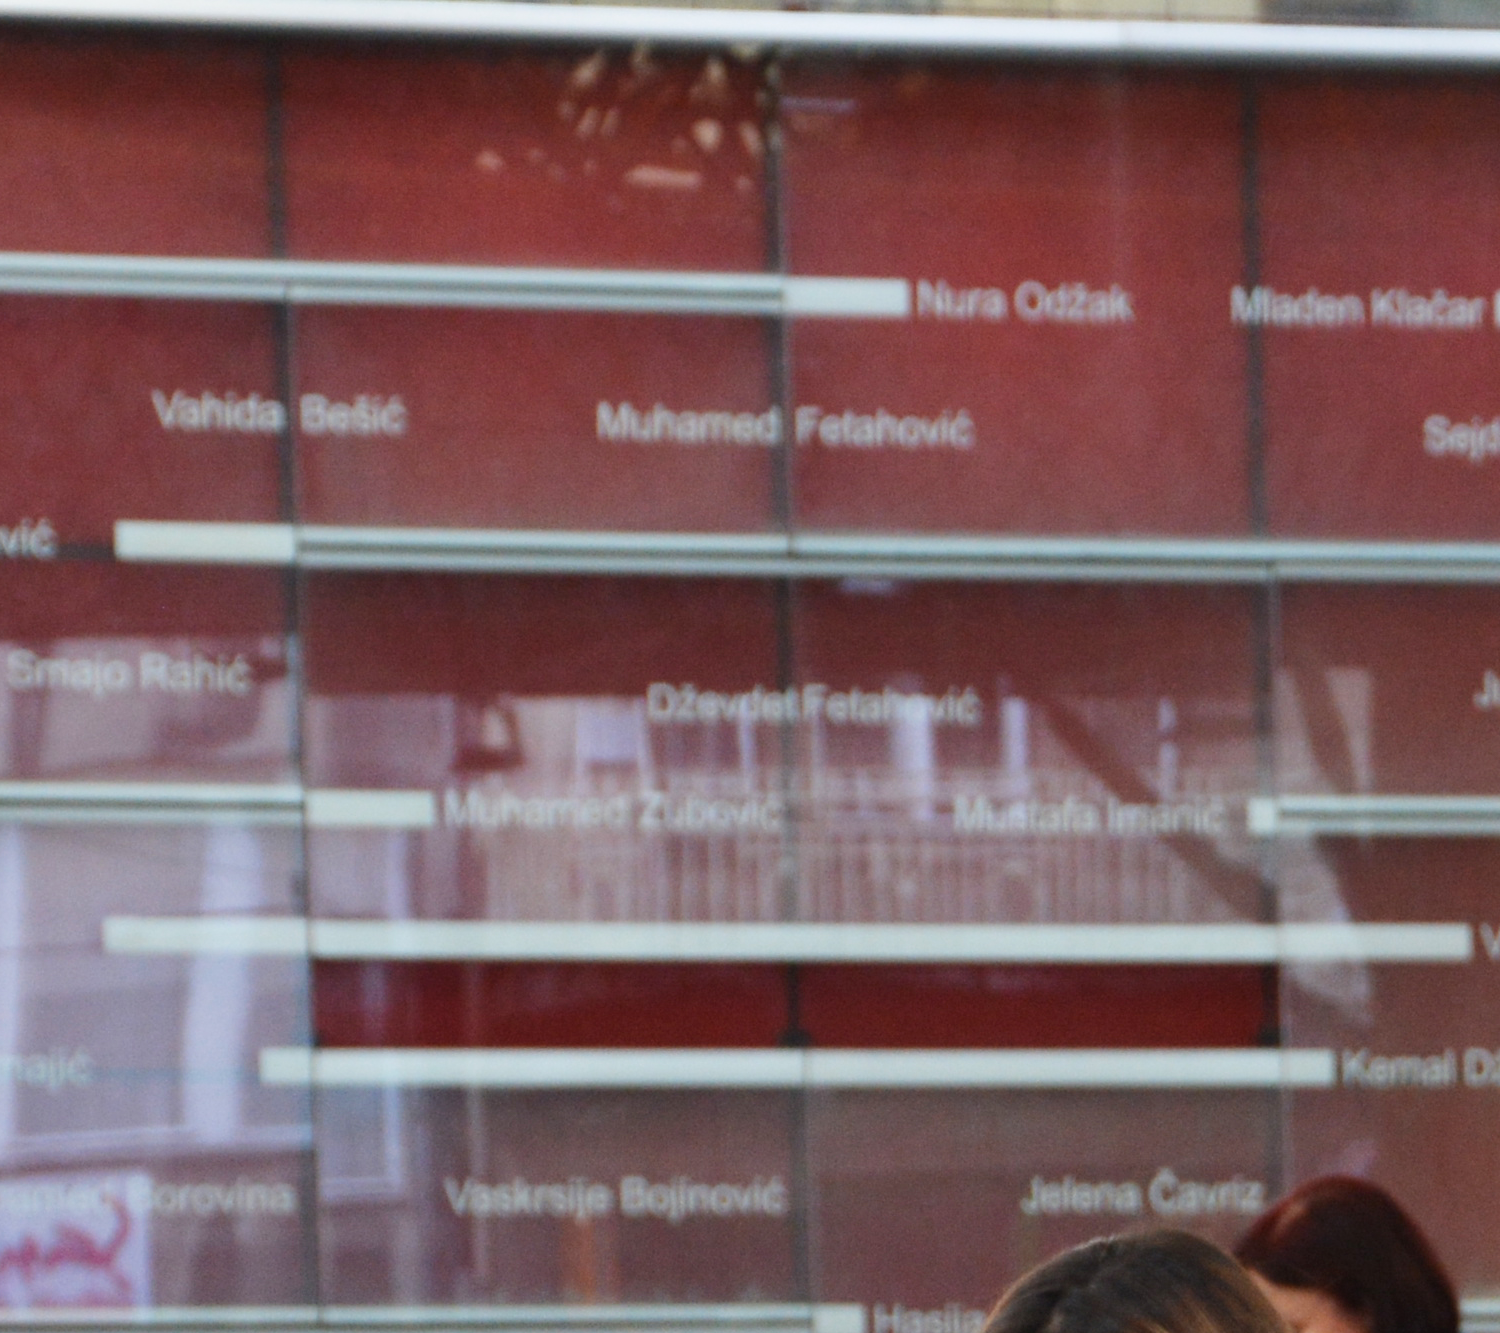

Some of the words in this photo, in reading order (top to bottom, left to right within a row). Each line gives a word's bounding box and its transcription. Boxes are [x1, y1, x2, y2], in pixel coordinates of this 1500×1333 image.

[917, 280, 1008, 320] Nura
[1015, 278, 1134, 323] Odžak
[1230, 285, 1364, 326] Mladen
[152, 390, 286, 434] Vahida
[596, 402, 782, 444] Muhamed
[796, 405, 976, 450] Fetahović
